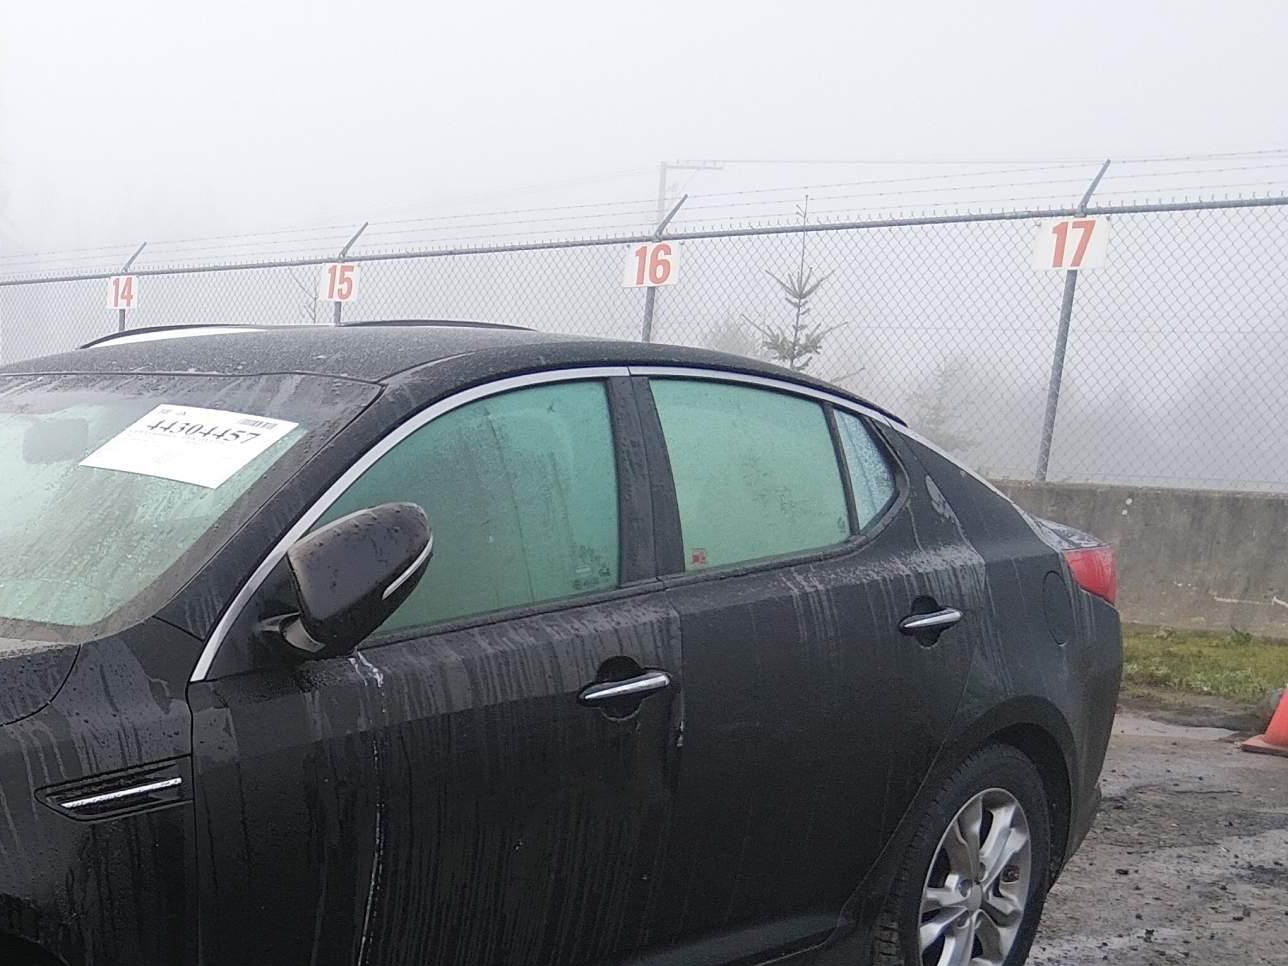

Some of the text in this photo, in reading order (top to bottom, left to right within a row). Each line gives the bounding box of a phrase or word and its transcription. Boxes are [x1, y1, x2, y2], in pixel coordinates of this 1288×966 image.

[1052, 219, 1097, 268] 17
[326, 264, 354, 300] 15
[635, 243, 673, 286] 16
[113, 276, 134, 307] 14
[146, 419, 261, 444] 44304457
